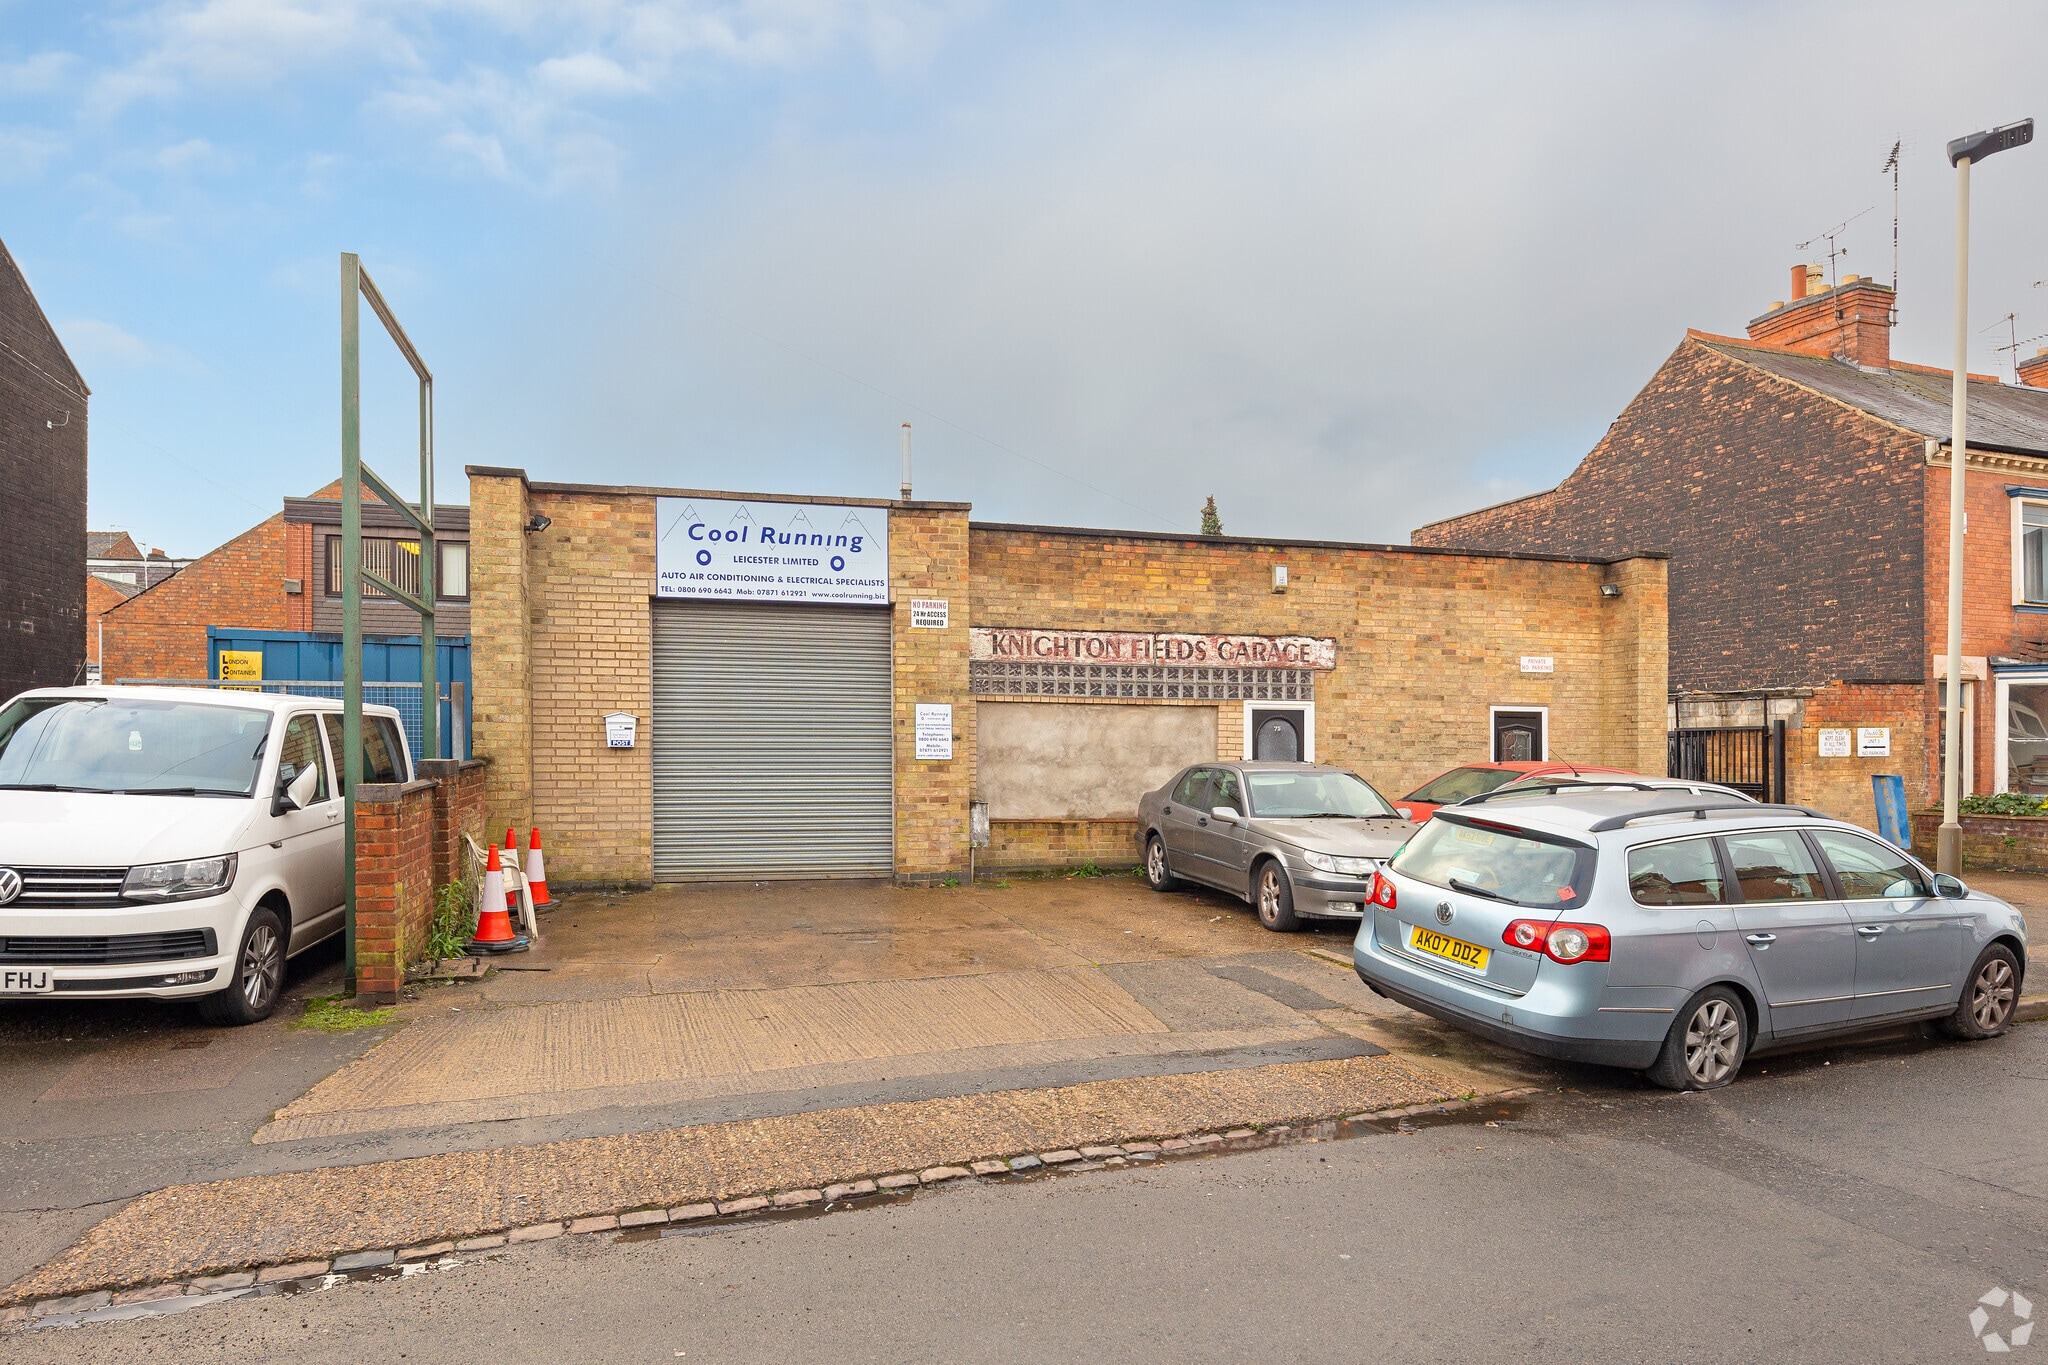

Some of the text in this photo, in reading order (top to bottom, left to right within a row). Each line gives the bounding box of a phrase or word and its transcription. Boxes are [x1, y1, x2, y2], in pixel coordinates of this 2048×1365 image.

[688, 523, 863, 553] Cool Running
[733, 555, 819, 566] LEICESTER LIMITED
[661, 571, 687, 580] AUTO
[689, 572, 704, 580] AIR
[707, 573, 775, 583] CONDITIONING
[786, 576, 834, 585] ELECTRICAL
[835, 578, 885, 587] SPECIALISTS
[660, 585, 675, 593] TEL:
[713, 587, 732, 595] 6643
[781, 589, 807, 597] 612921
[812, 591, 885, 600] www.coolrunning.biz
[922, 601, 947, 609] PARKING
[992, 634, 1311, 662] KNIGHTON FIELDS GARAGE
[222, 655, 248, 664] LONDON
[222, 666, 256, 675] CONTAINER
[1416, 930, 1482, 964] AK07 DDZ
[5, 972, 46, 988] FHJ
